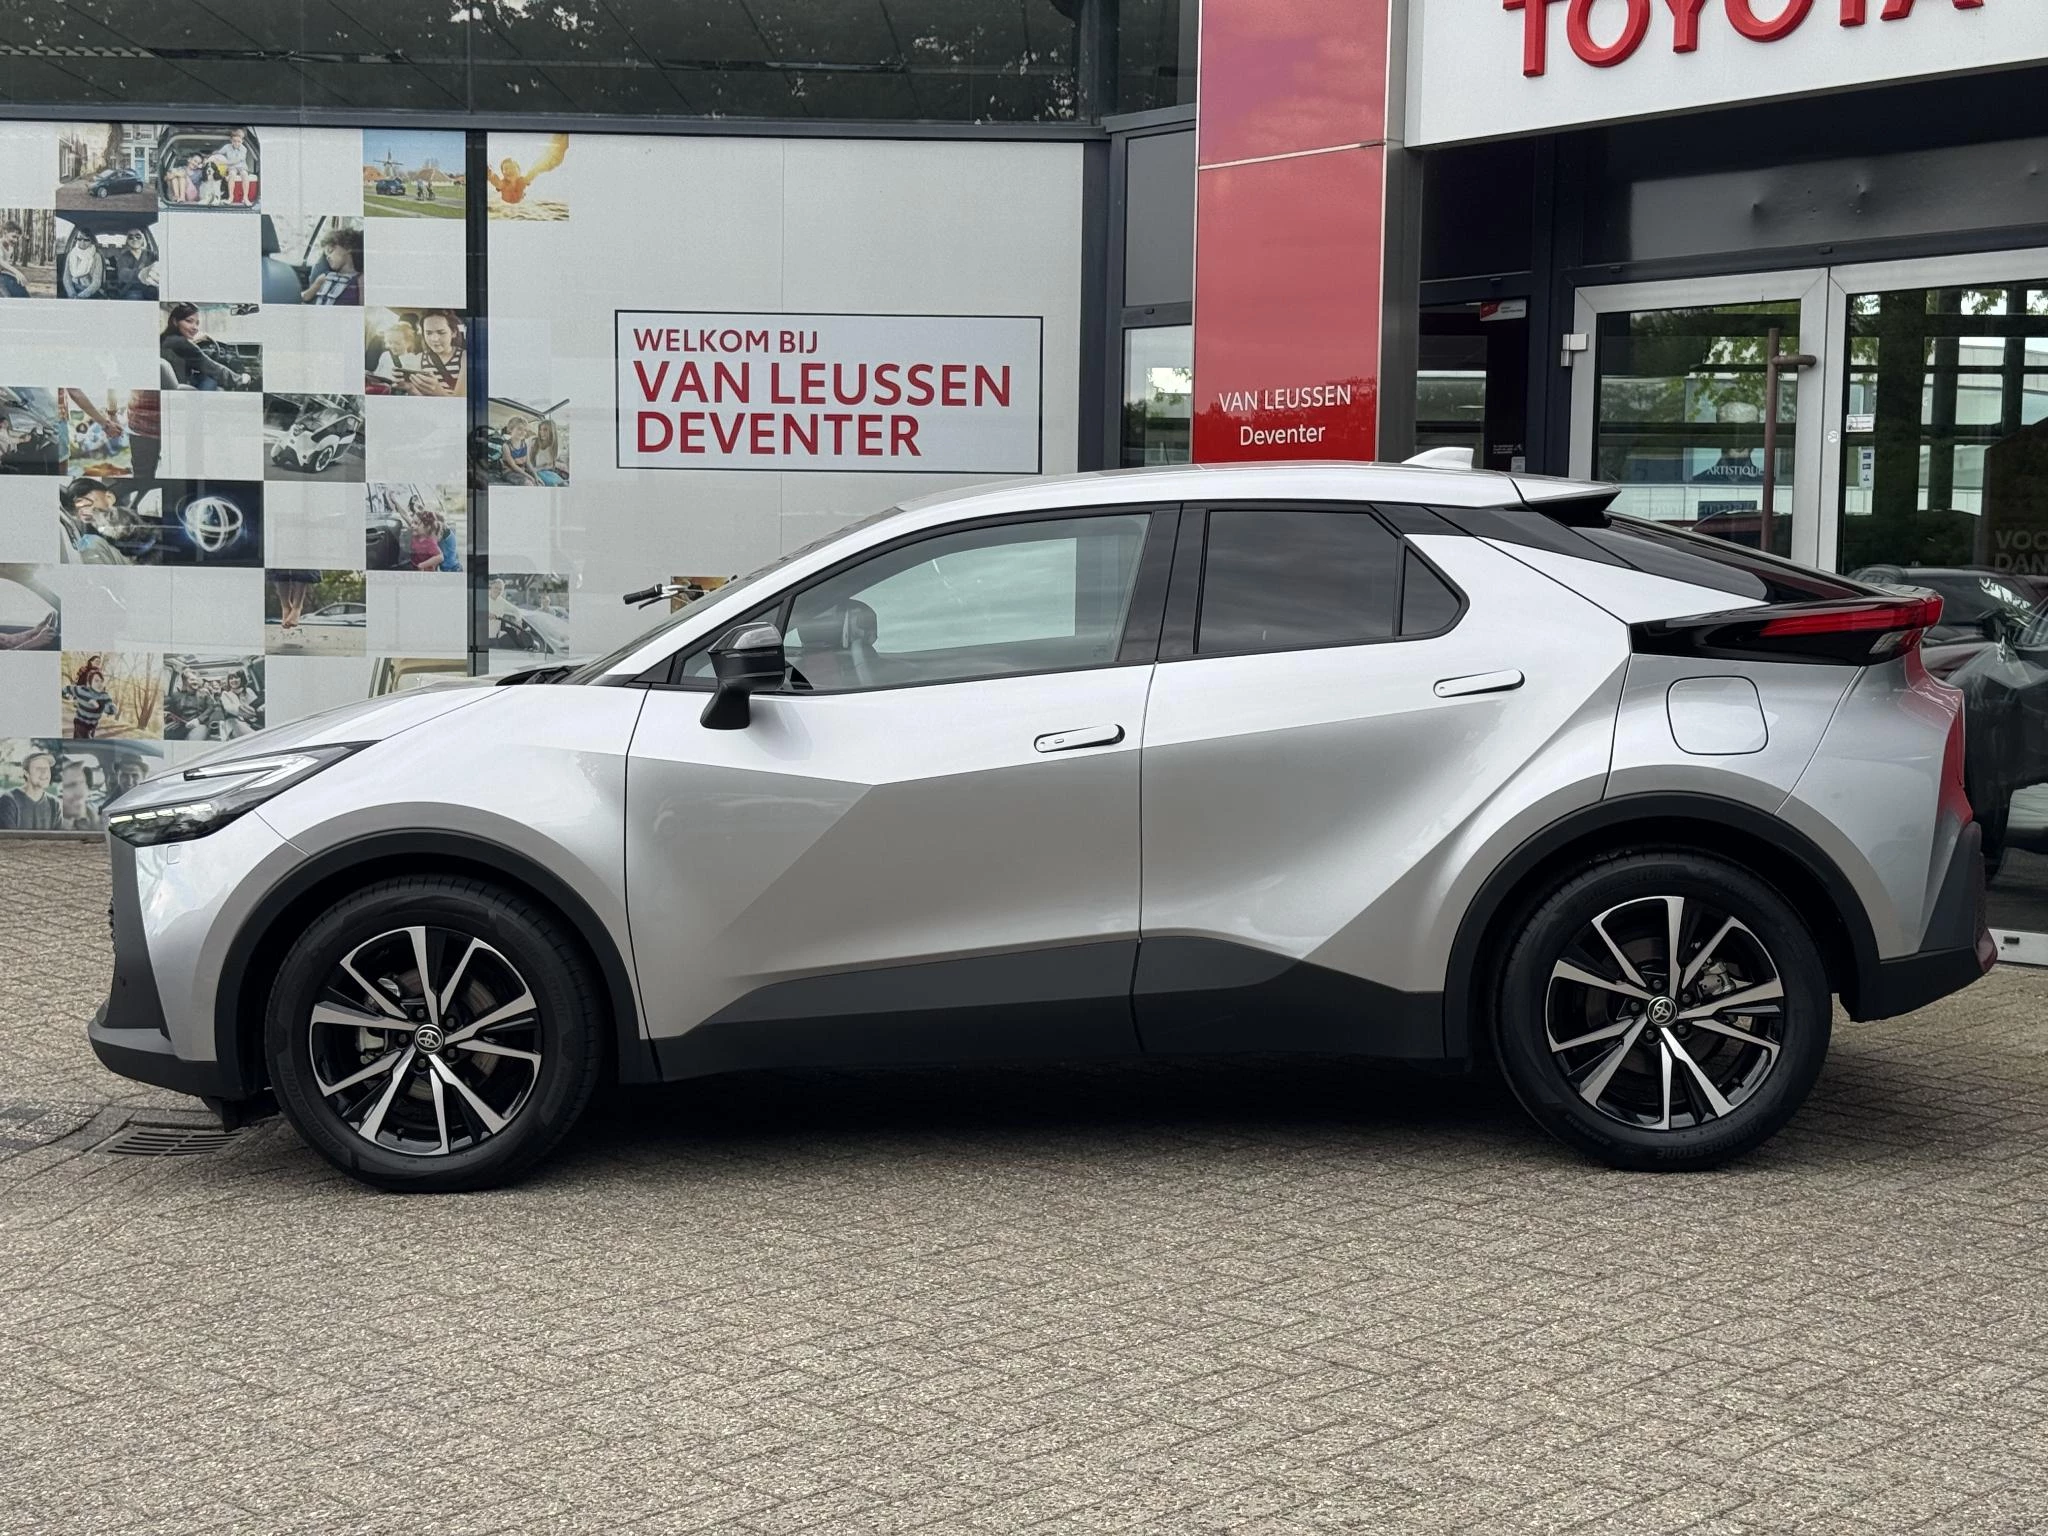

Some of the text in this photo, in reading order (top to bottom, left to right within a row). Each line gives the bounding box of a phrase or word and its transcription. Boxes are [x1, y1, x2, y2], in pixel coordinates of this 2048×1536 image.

[1503, 0, 1985, 78] TOY
[633, 328, 818, 354] WELKOM BIJ
[633, 360, 1011, 407] VAN LEUSSEN
[1218, 384, 1351, 413] VAN LEUSSEN
[636, 411, 922, 457] DEVENTER
[1240, 424, 1326, 446] Deventer
